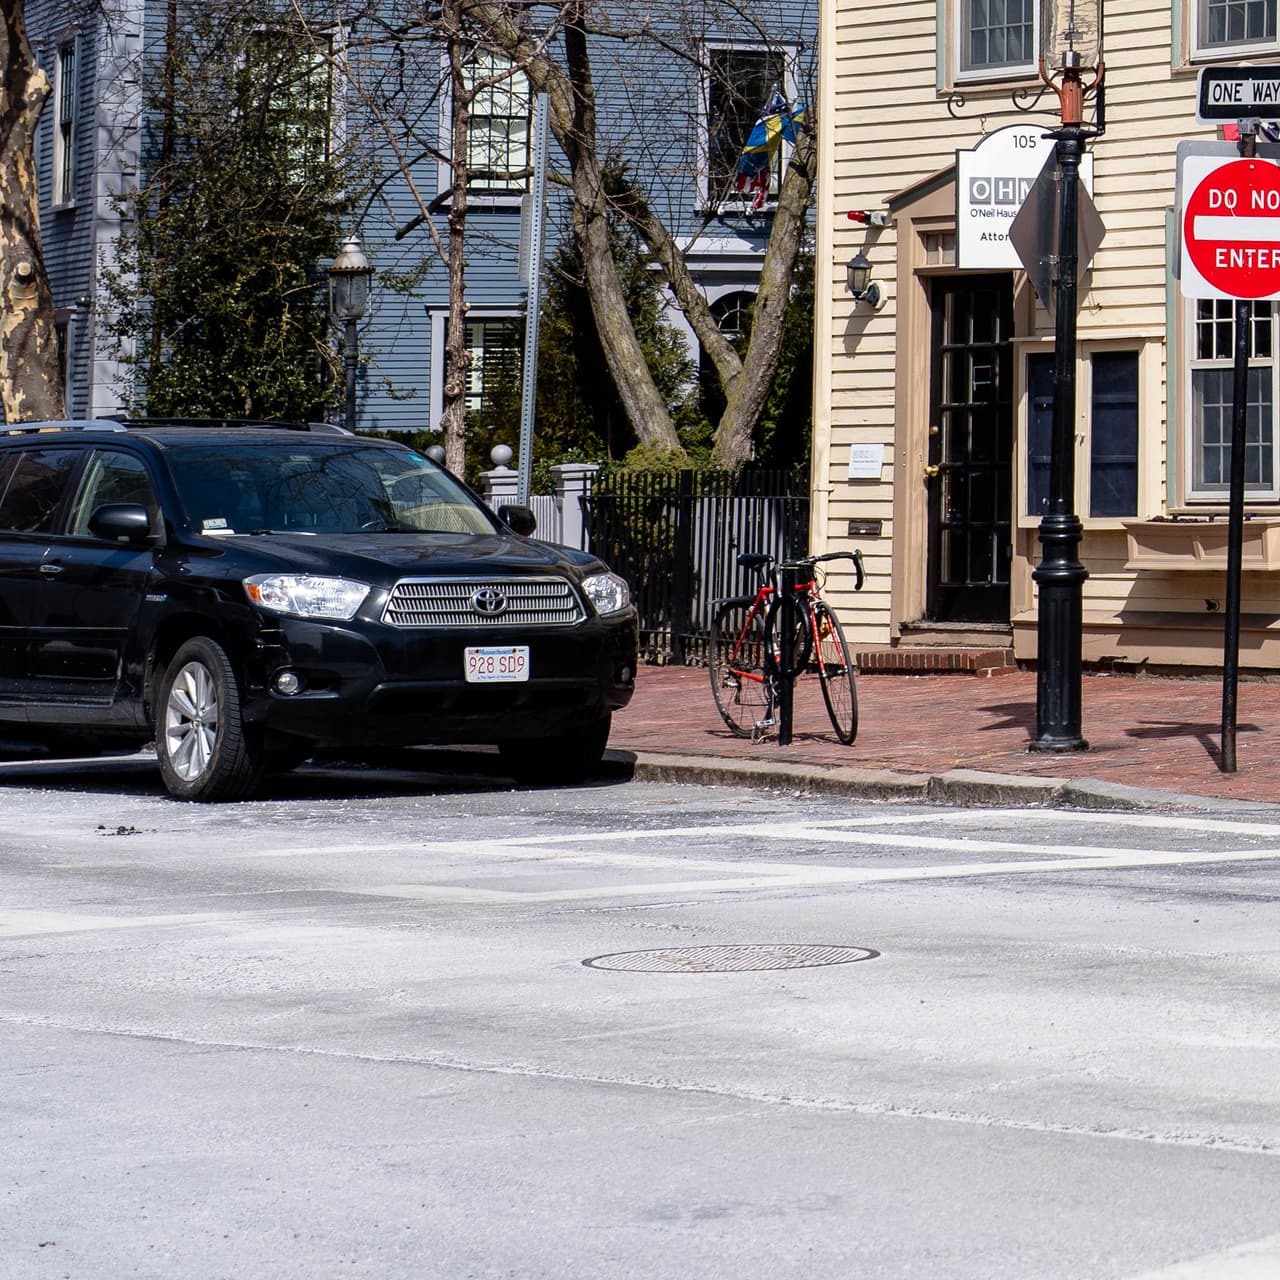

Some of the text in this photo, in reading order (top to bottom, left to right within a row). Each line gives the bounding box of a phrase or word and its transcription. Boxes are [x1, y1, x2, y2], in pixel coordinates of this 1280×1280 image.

[1212, 82, 1280, 102] ONE WAY
[1013, 135, 1036, 148] 105
[1208, 189, 1237, 209] DO
[970, 208, 995, 218] O'Neil
[469, 656, 525, 673] 928 SD9
